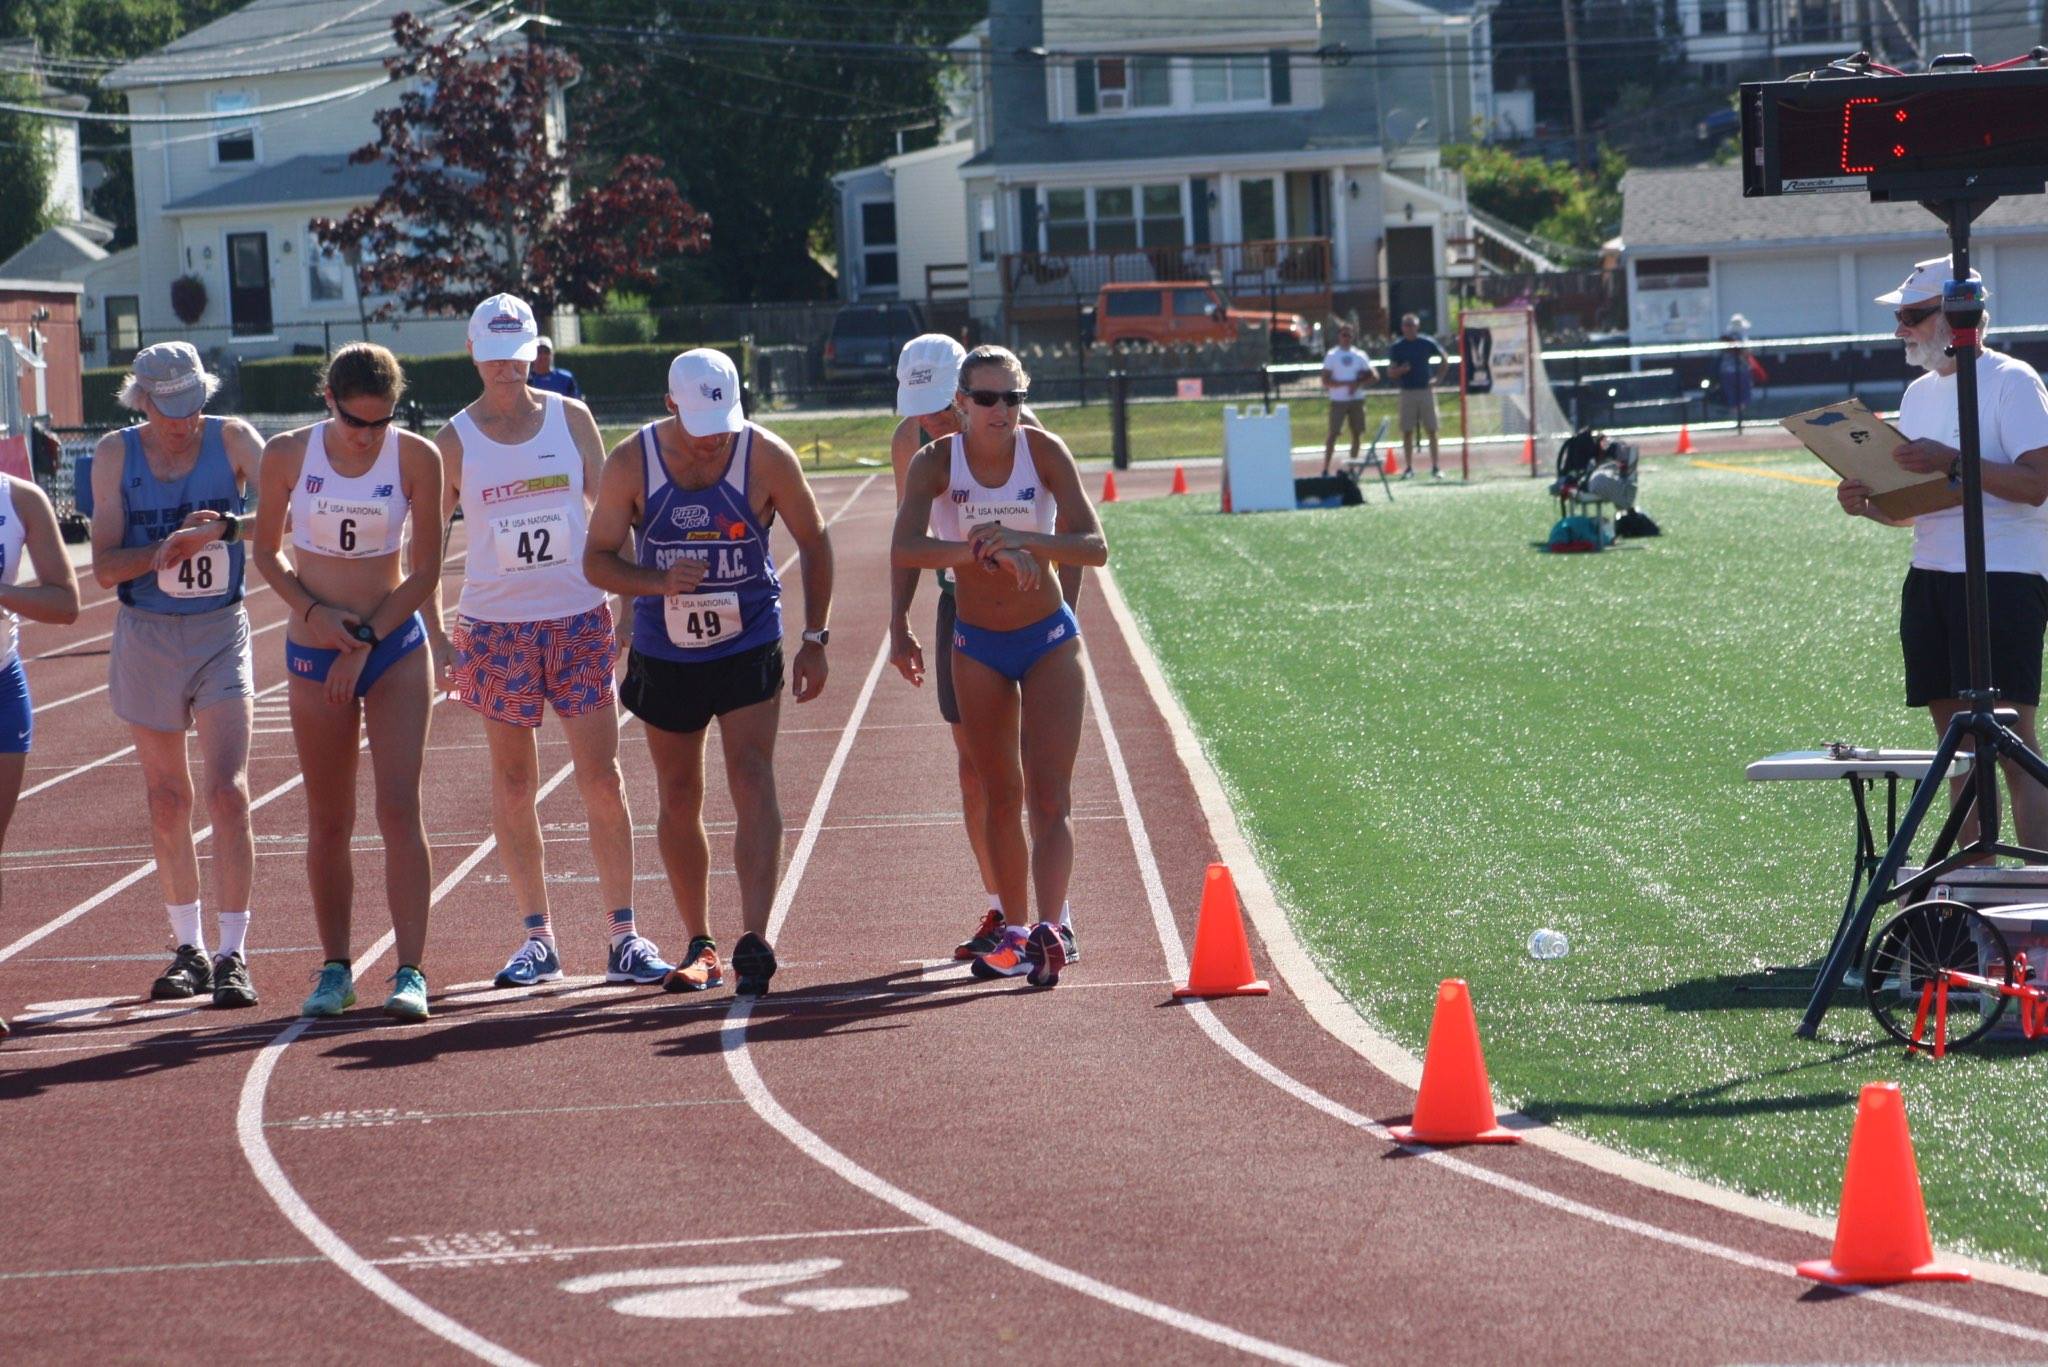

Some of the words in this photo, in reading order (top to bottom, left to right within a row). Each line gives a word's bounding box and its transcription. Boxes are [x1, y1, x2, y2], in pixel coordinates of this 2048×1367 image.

[162, 498, 230, 525] ENGAND
[330, 505, 344, 513] USA
[346, 506, 382, 515] NATIONAL
[978, 507, 993, 515] USA
[994, 506, 1029, 515] NATIONAL
[339, 518, 356, 551] 6
[516, 528, 553, 564] 42
[178, 555, 213, 590] 48
[717, 548, 748, 579] A.C.
[681, 601, 695, 609] USA
[697, 598, 732, 608] NATIONAL
[687, 610, 722, 640] 49
